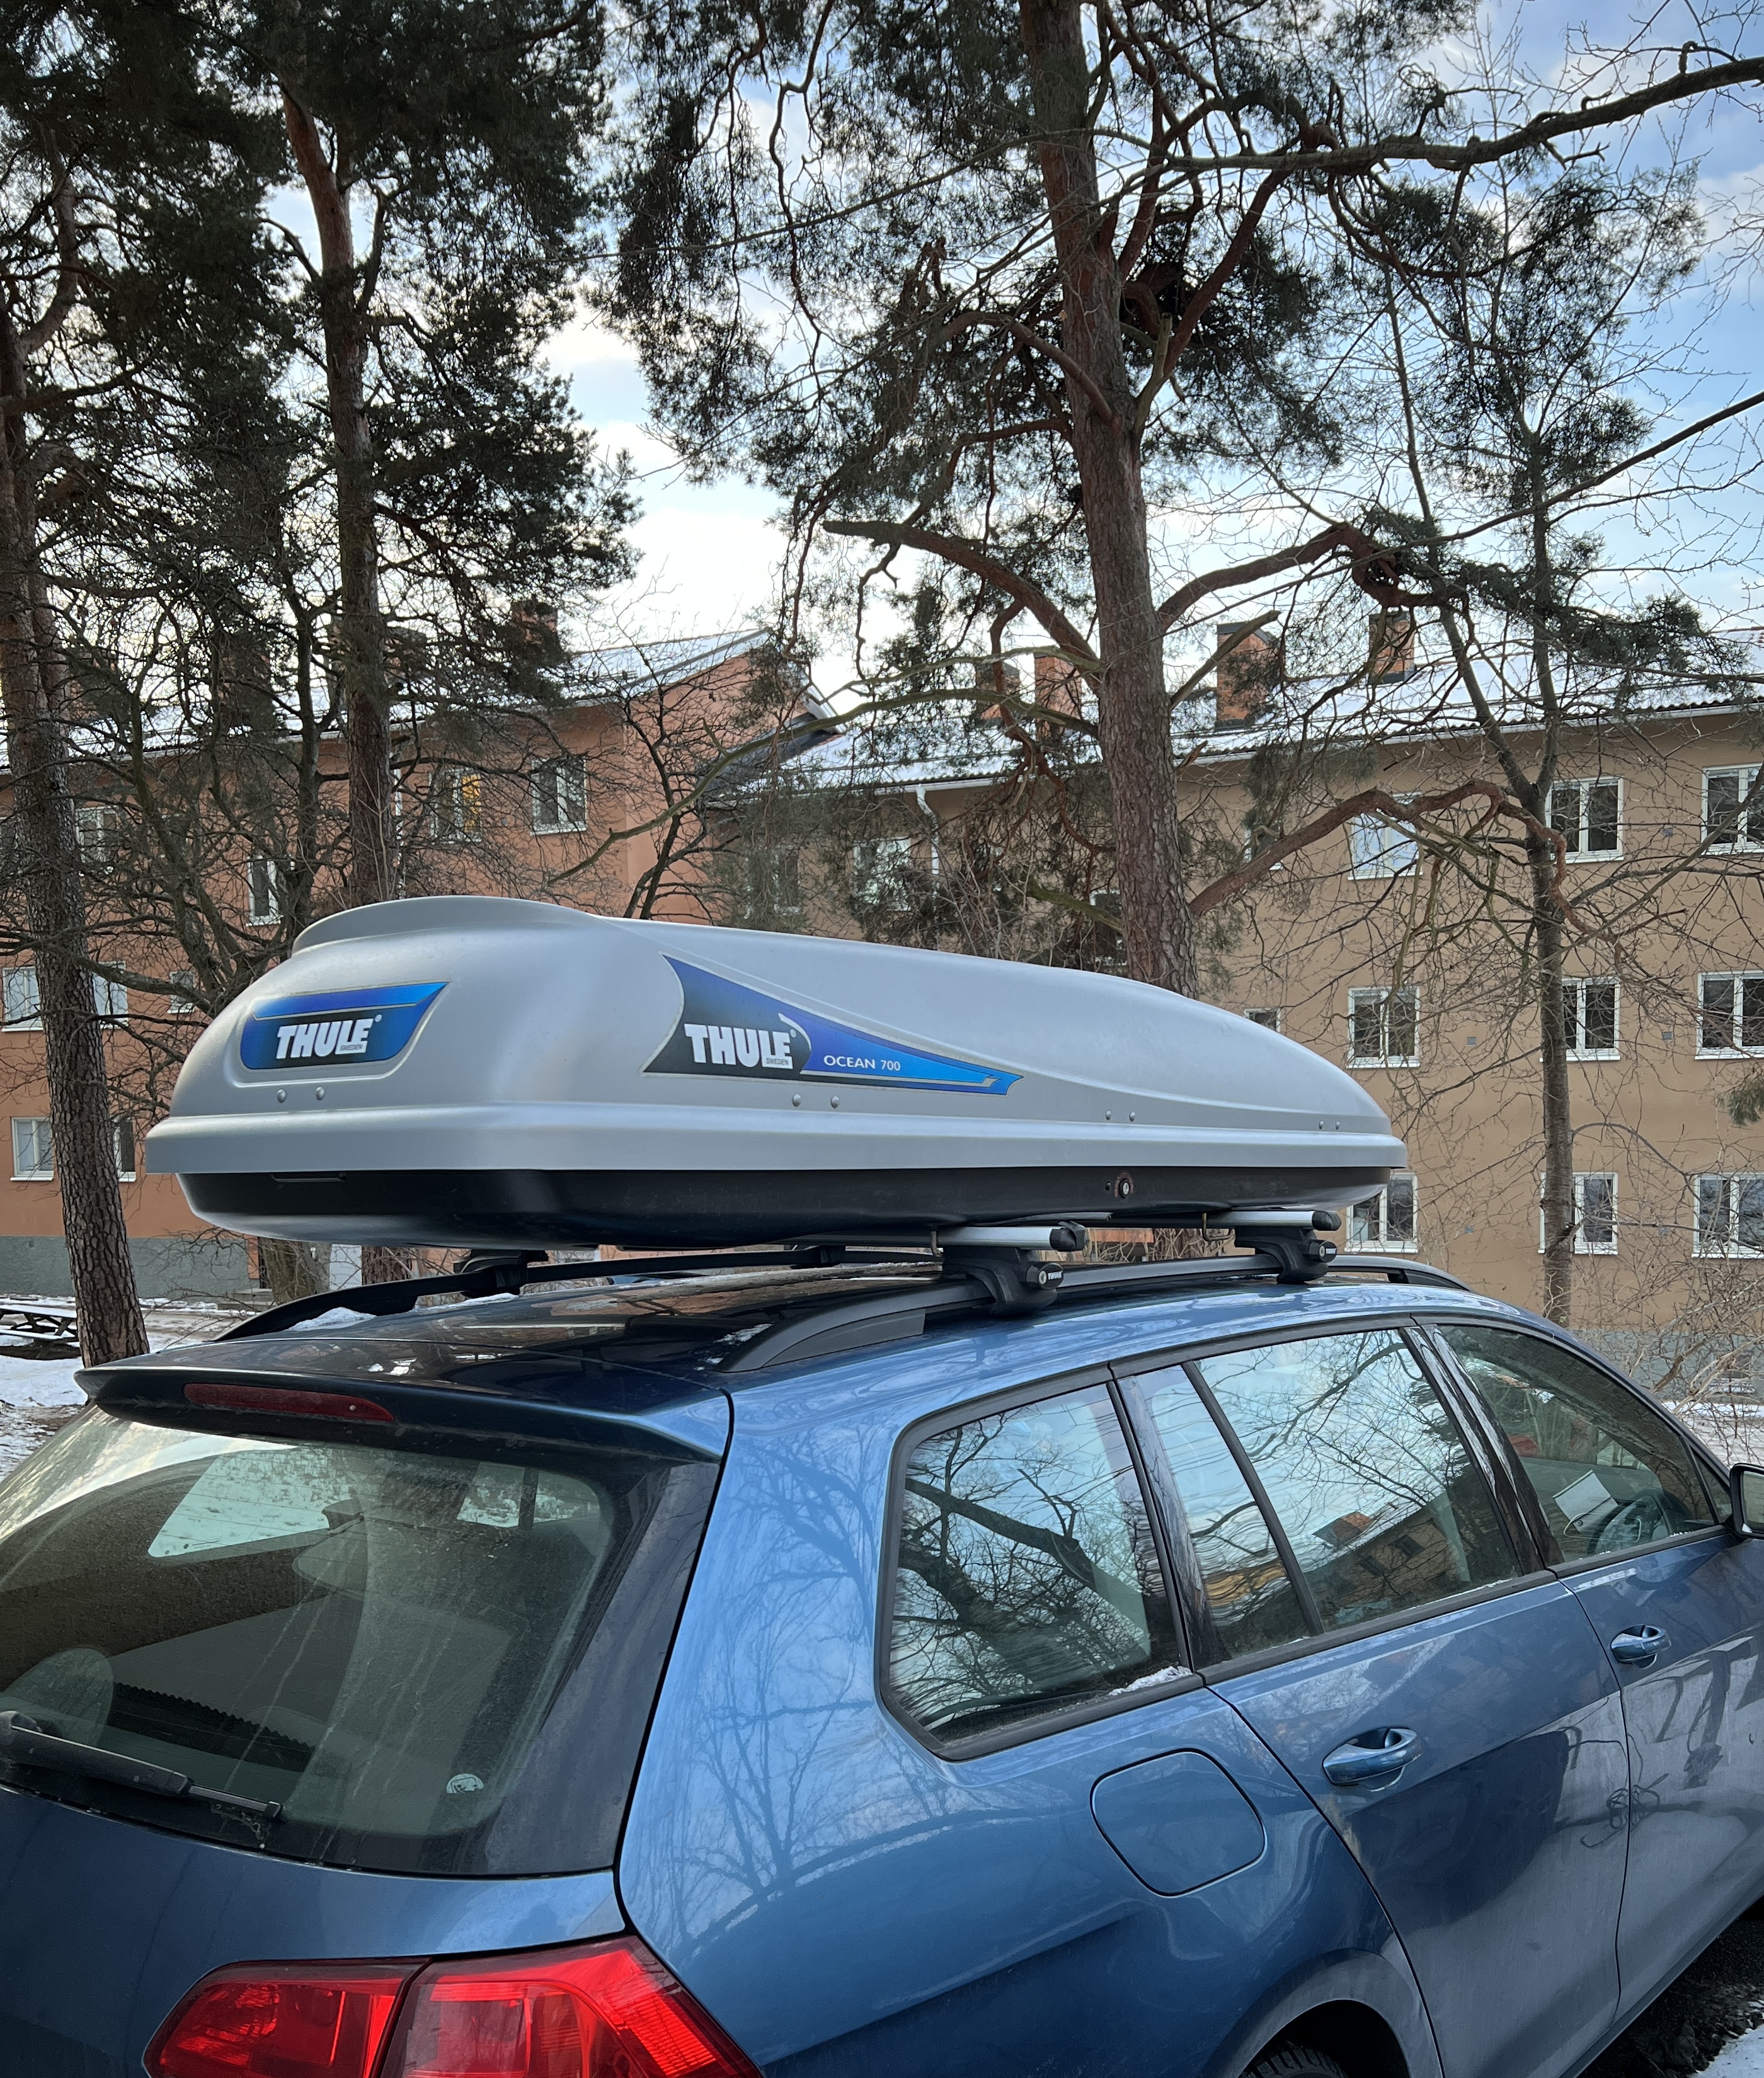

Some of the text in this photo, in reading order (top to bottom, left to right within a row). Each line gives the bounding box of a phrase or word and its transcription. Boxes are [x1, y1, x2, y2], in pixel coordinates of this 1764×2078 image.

[276, 1019, 374, 1059] THULE
[684, 1024, 793, 1070] THULE
[823, 1055, 901, 1071] OCEAN 700
